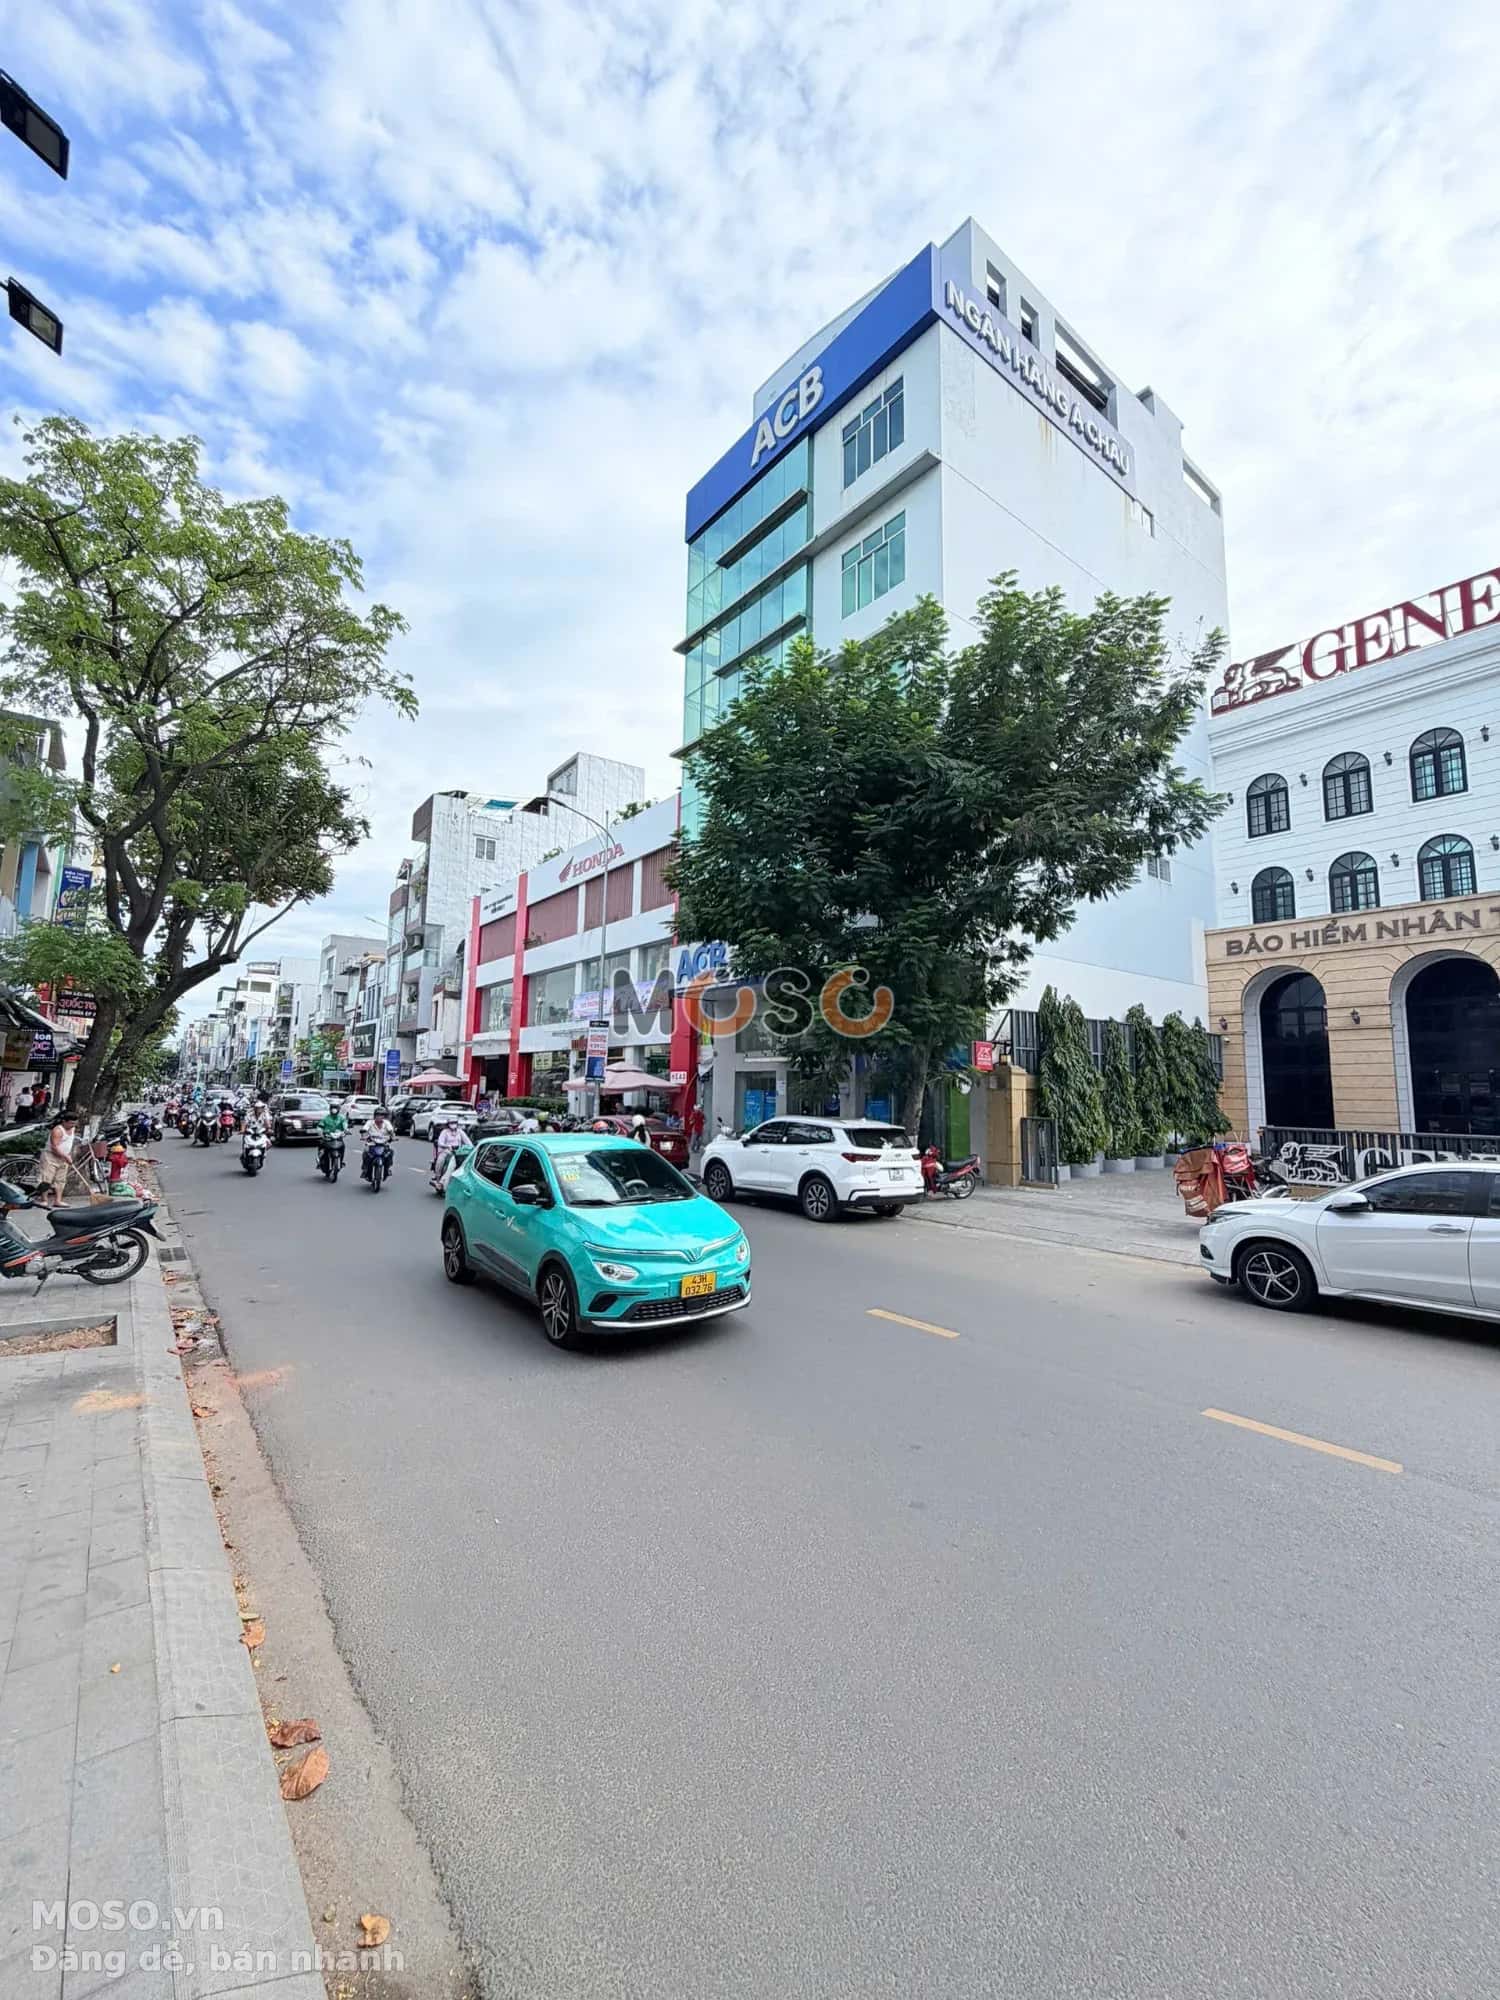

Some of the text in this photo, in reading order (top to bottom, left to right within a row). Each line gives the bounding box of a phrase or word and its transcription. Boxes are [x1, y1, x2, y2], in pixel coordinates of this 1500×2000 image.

[945, 280, 1129, 476] NGÂN HÀNG Á CHÂU
[751, 366, 824, 468] ACB
[572, 843, 624, 877] HONDA
[1226, 932, 1283, 957] BẢO
[1291, 918, 1368, 949] HIỂM
[1376, 909, 1481, 939] NHÂN
